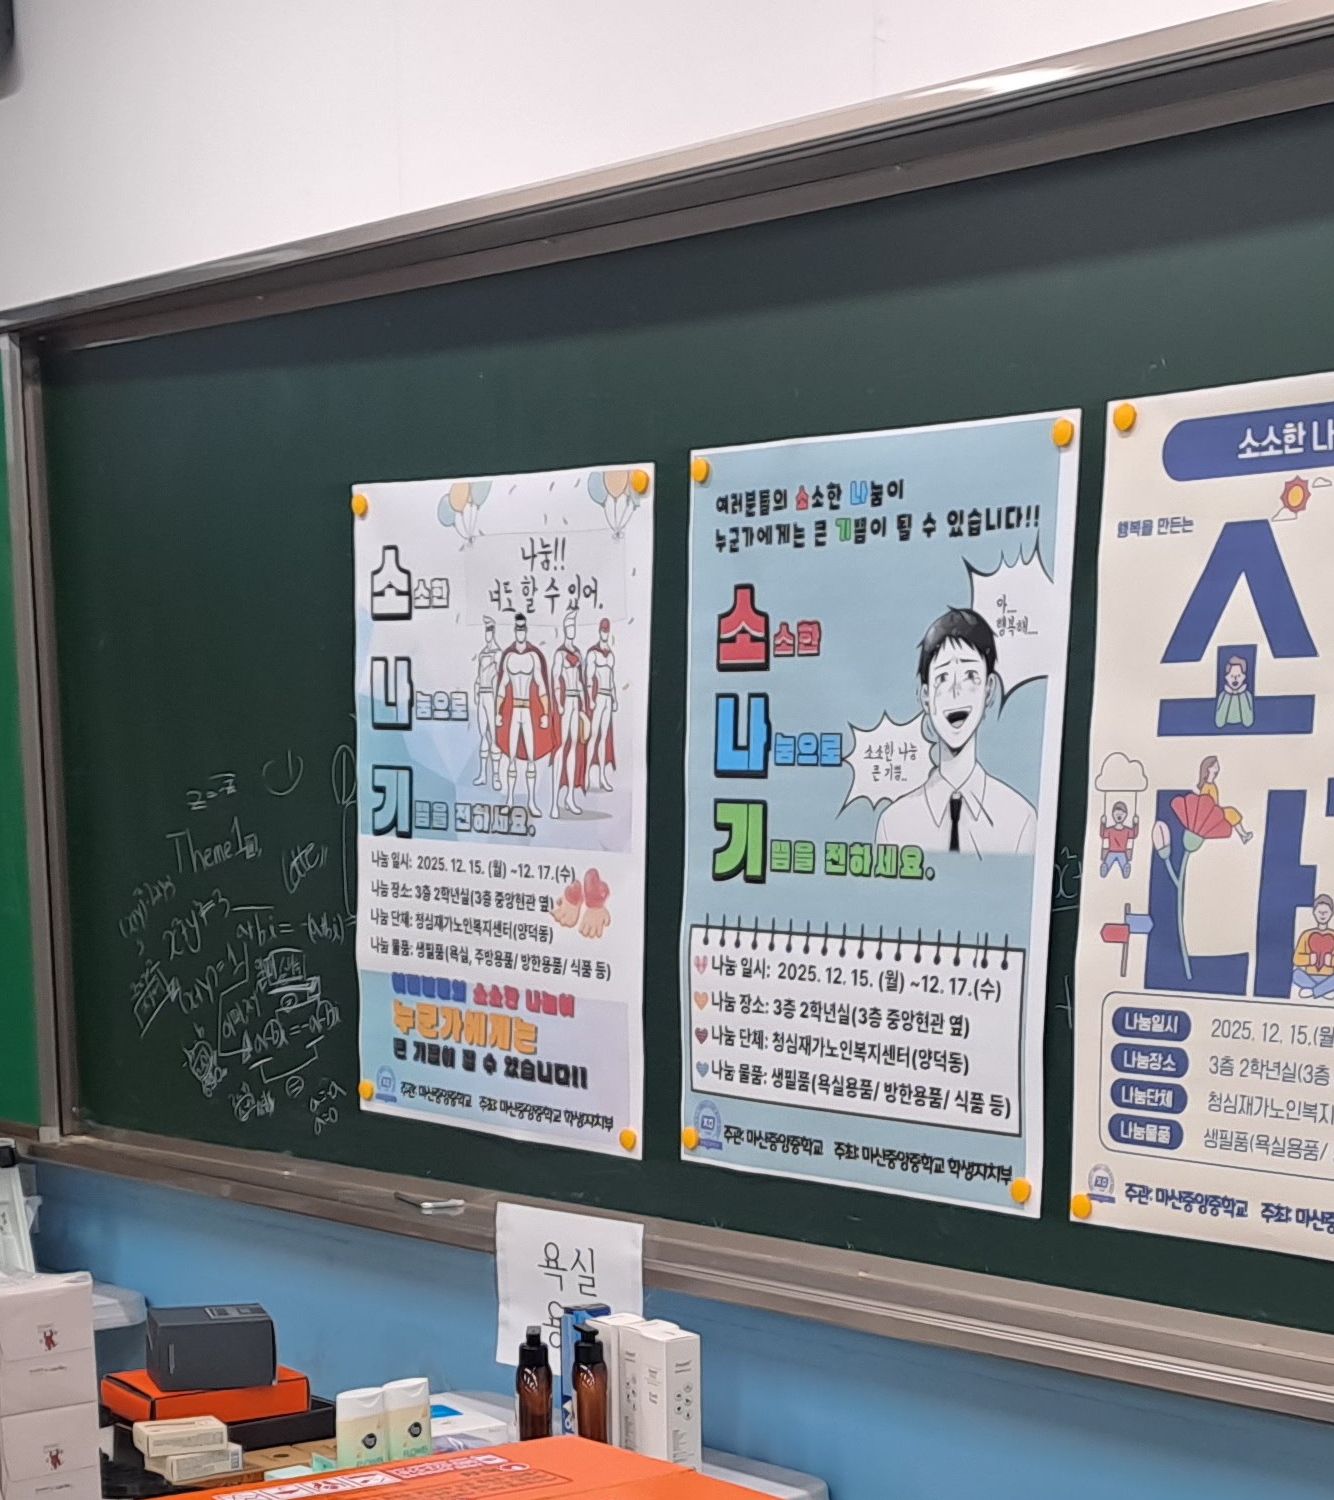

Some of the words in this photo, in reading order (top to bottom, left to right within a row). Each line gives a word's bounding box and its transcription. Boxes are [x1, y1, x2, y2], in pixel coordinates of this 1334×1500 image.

[1236, 420, 1306, 459] 소소한
[716, 489, 787, 517] 여러분들의
[795, 483, 842, 511] 소소한
[850, 479, 904, 507] 나눔이
[716, 523, 805, 553] 누군가에게는
[815, 519, 826, 547] 큰
[835, 516, 886, 544] 기쁨이
[896, 513, 912, 541] 될
[923, 513, 936, 538] 수
[947, 505, 1040, 537] 있습니다!!
[520, 537, 566, 571] 나눔!!
[545, 580, 559, 614] 수
[712, 956, 736, 978] 나눔
[741, 958, 771, 980] 일시:
[778, 962, 820, 983] 2025.
[879, 969, 905, 994] (월)
[712, 992, 735, 1013] 나눔
[739, 995, 769, 1016] 장소:
[773, 998, 796, 1019] 3층
[800, 1002, 882, 1029] 2학년실(3층
[887, 1009, 944, 1034] 중앙현관
[1124, 1013, 1178, 1035] 나눔일시
[1211, 1018, 1255, 1040] 2025.
[1262, 1023, 1283, 1043] 12.
[773, 1031, 969, 1076] 청심재가노인복지센터(양덕동)
[1123, 1048, 1176, 1073] 나눔장소
[1209, 1057, 1234, 1076] 3층
[1239, 1058, 1330, 1087] 2학년실(3층
[1121, 1084, 1174, 1108] 나눔단체
[1203, 1129, 1328, 1162] 생필품(욕실용품/
[1155, 1188, 1248, 1218] 마산중앙중학교
[537, 1241, 598, 1297] 욕실
